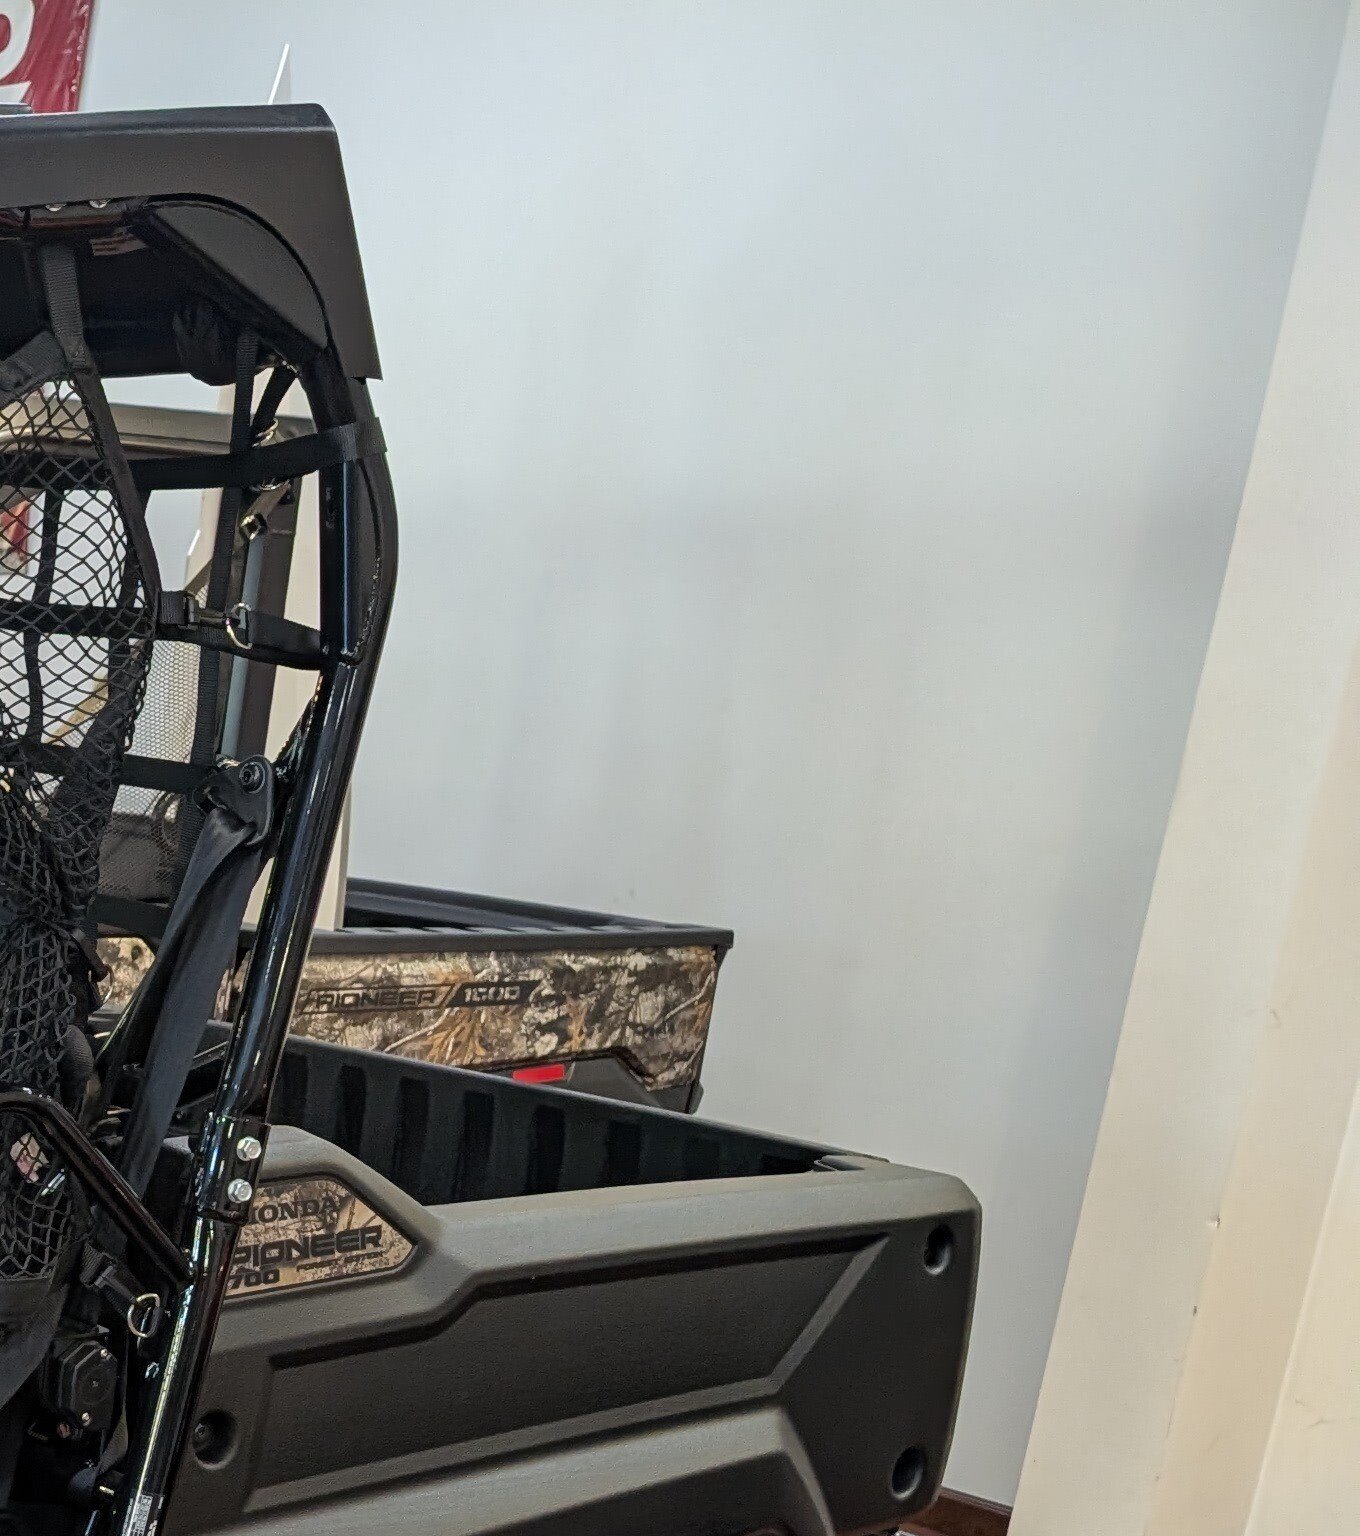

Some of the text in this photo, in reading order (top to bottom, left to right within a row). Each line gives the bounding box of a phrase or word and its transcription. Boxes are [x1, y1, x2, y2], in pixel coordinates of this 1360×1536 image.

[315, 988, 437, 1010] PIONEER
[249, 1197, 340, 1224] ONDA
[228, 1267, 280, 1289] 700
